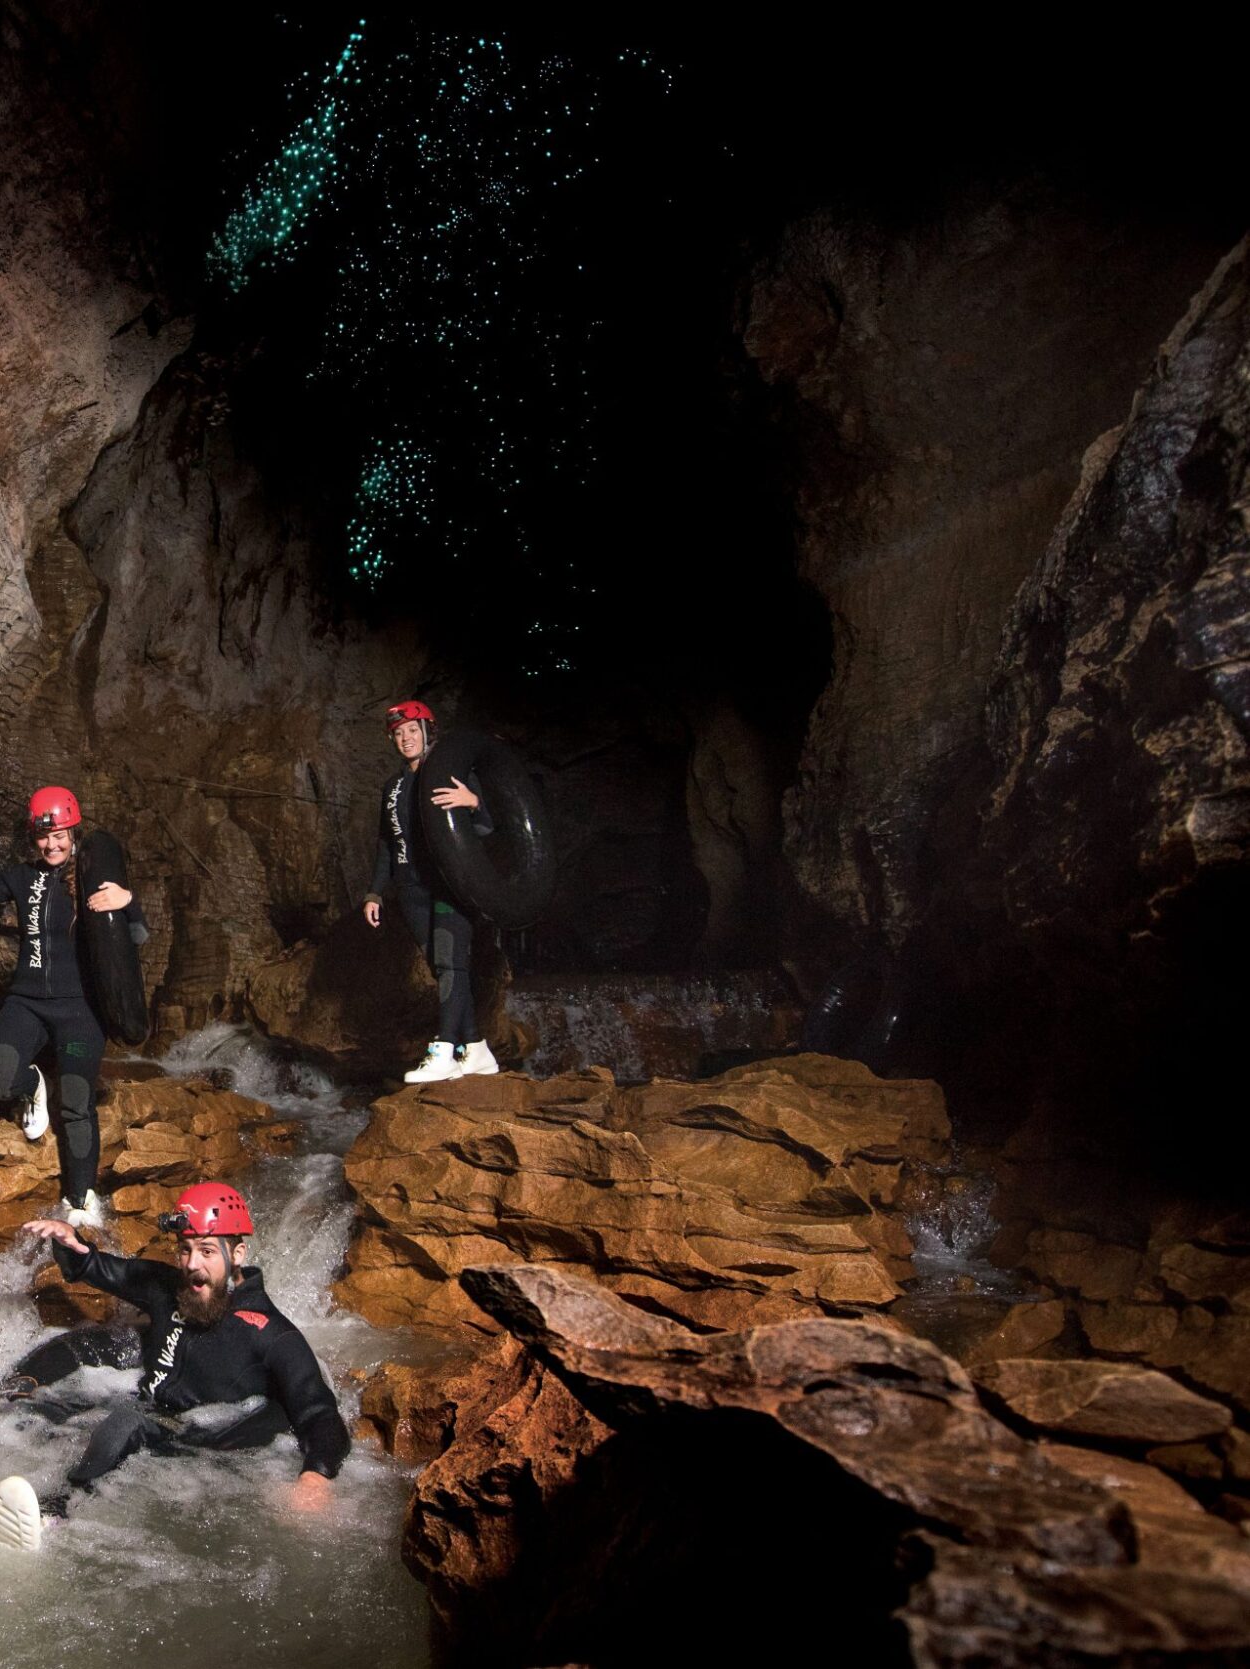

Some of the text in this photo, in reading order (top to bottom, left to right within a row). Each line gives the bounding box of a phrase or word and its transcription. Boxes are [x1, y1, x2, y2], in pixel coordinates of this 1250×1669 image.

[27, 871, 49, 969] Black Water Rafting
[157, 1327, 183, 1368] Water
